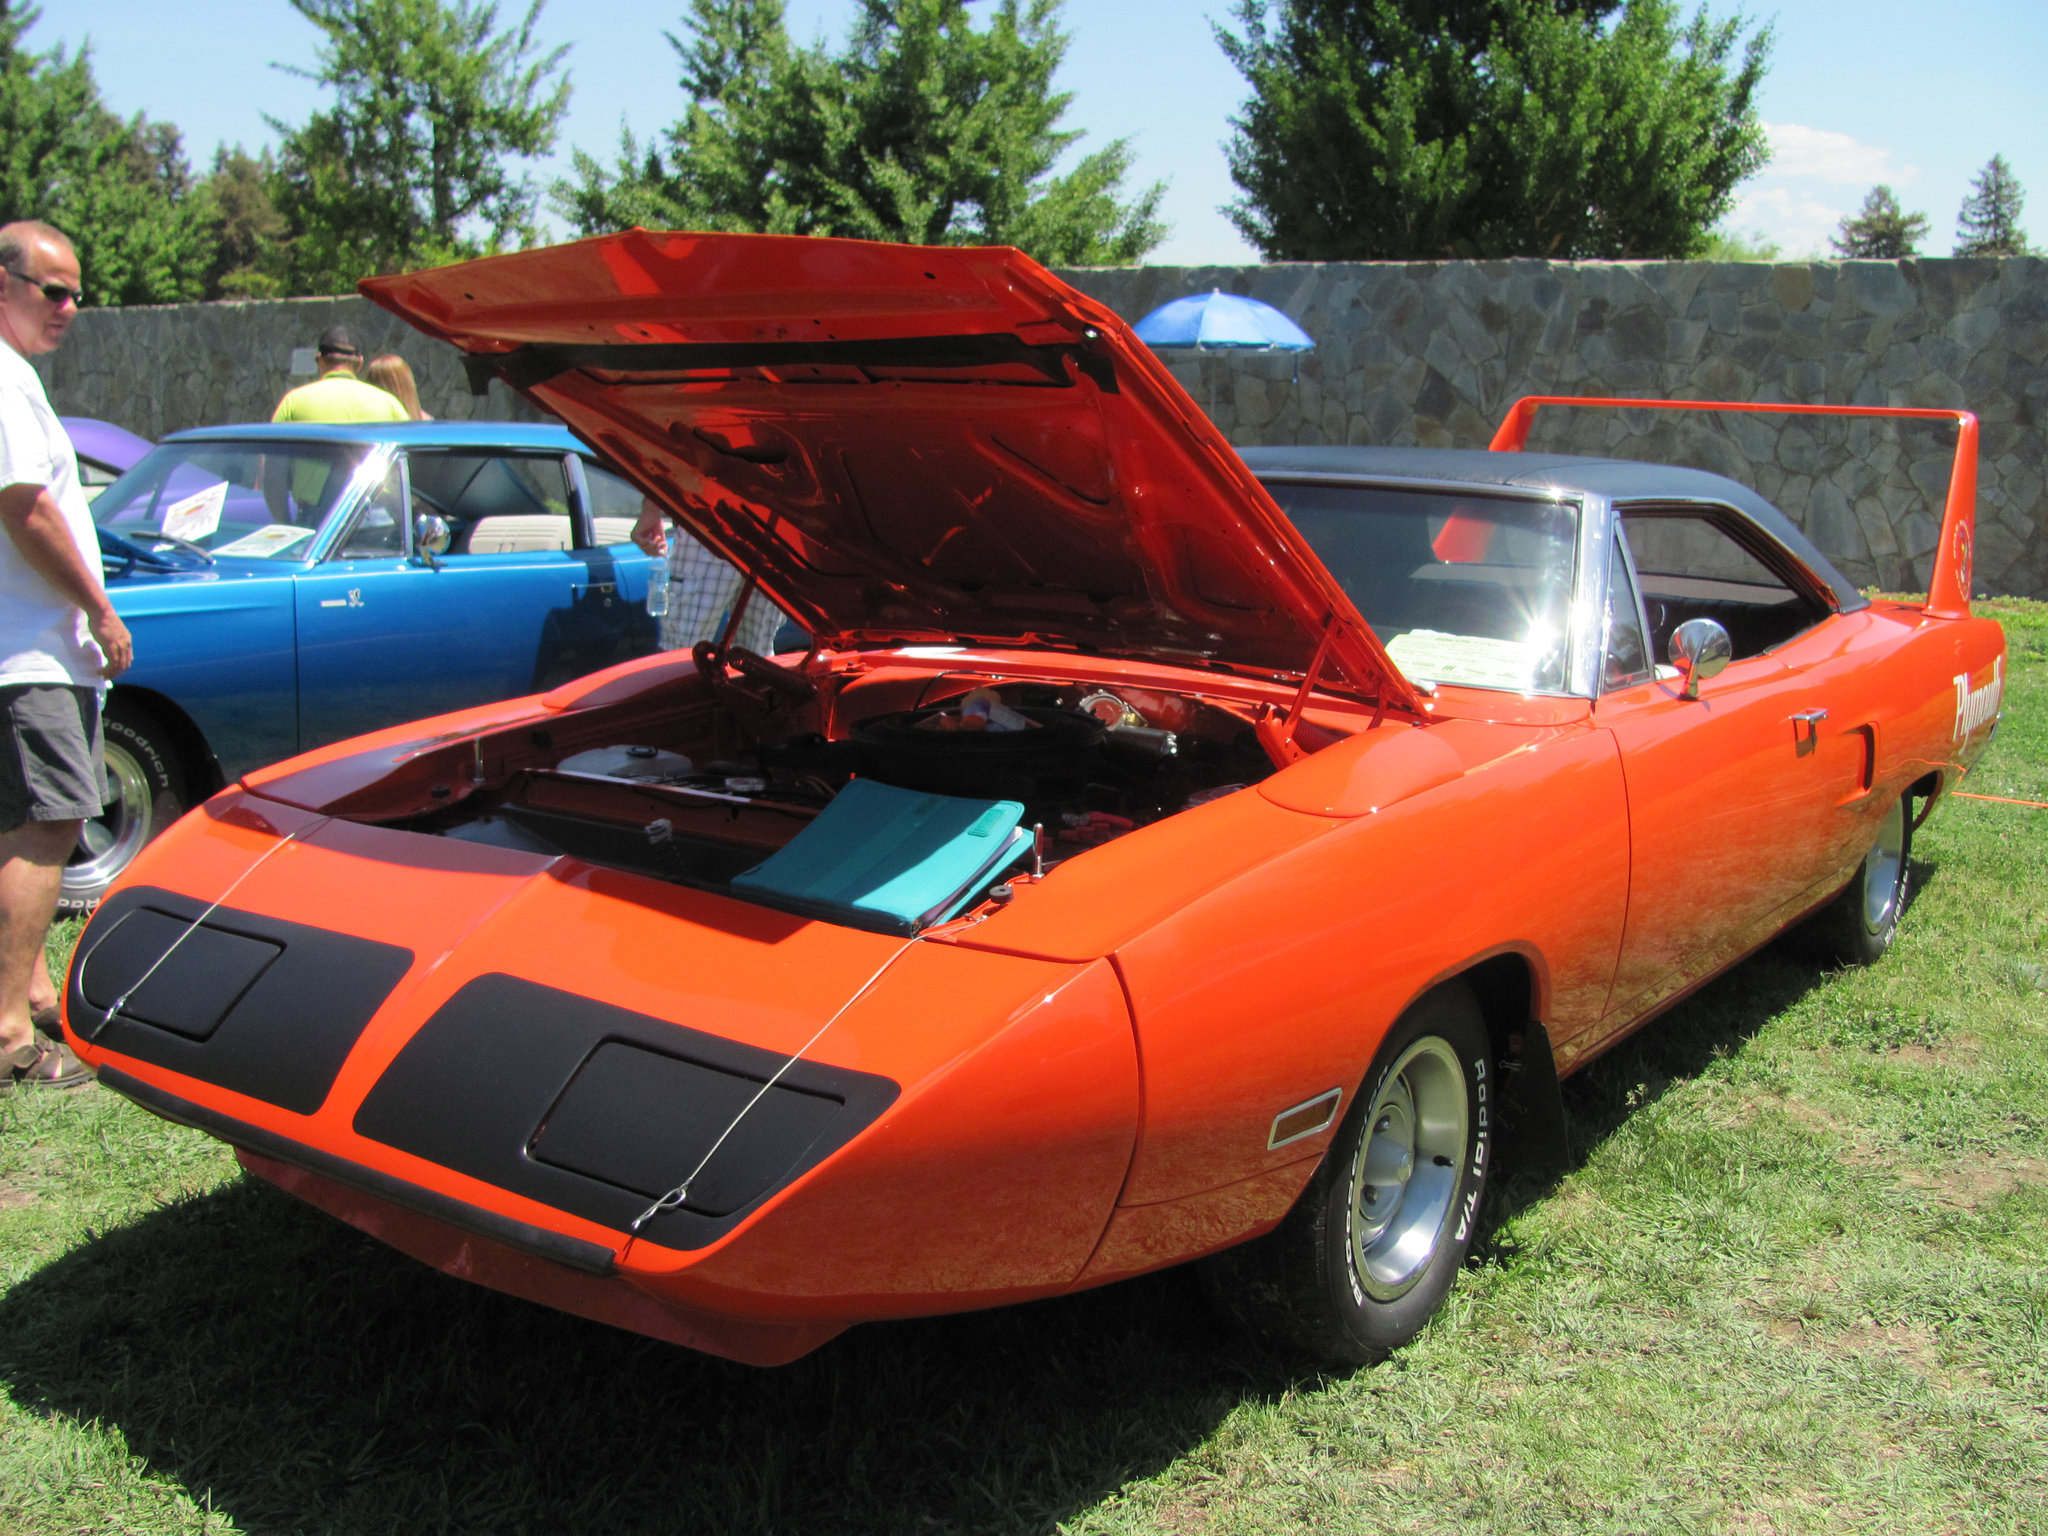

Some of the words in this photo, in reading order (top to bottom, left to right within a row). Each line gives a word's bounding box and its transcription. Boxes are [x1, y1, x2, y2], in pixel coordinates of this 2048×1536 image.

[1953, 654, 2003, 755] Plymouth
[1473, 1058, 1488, 1177] Radial
[1455, 1190, 1477, 1241] T/A
